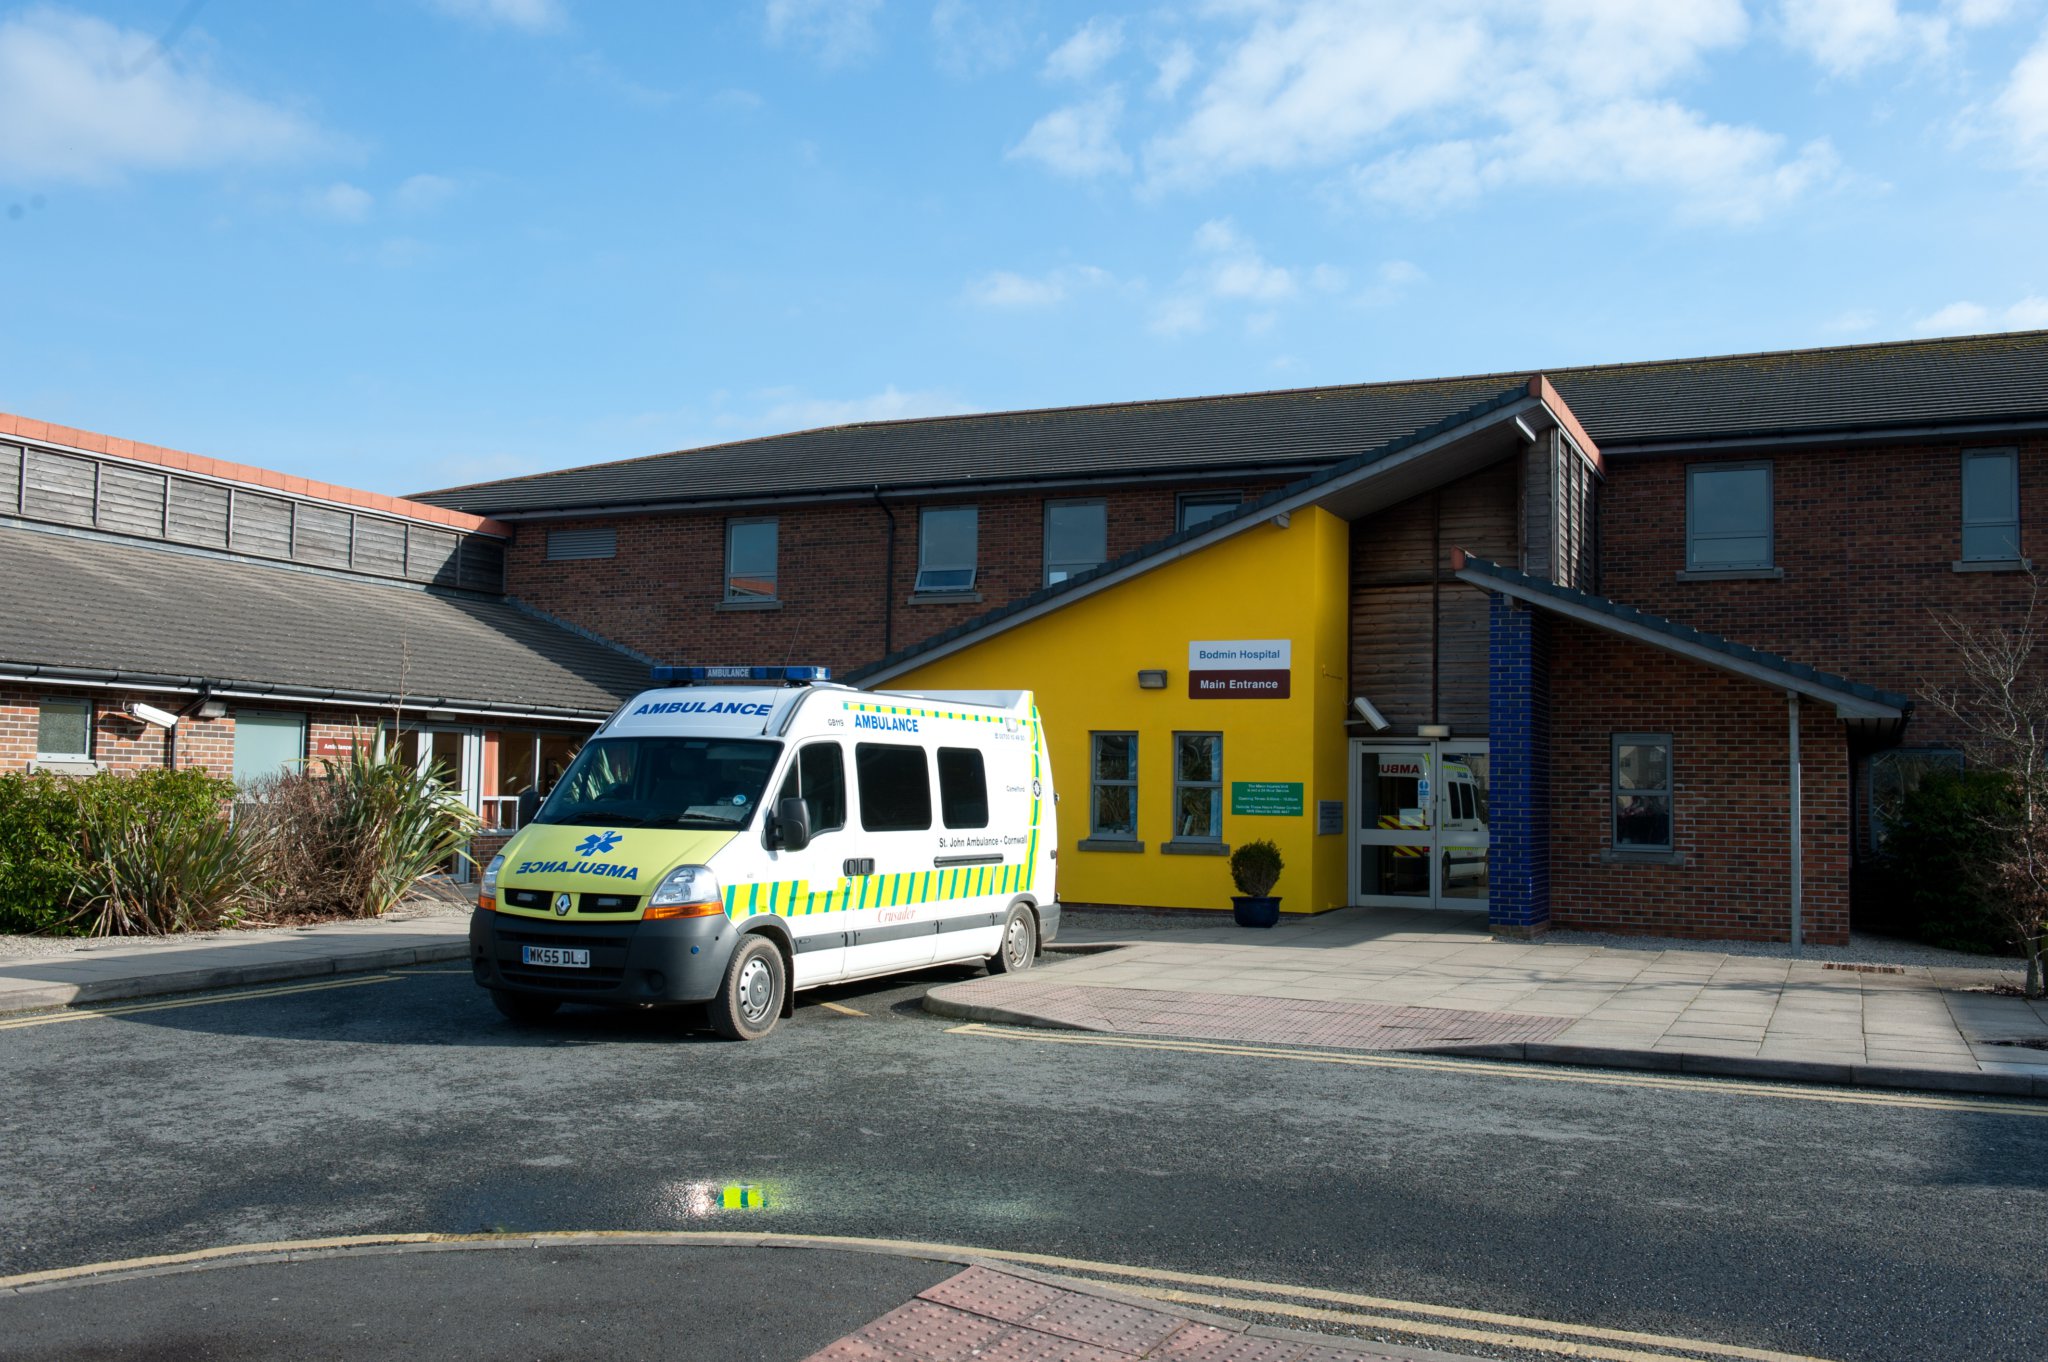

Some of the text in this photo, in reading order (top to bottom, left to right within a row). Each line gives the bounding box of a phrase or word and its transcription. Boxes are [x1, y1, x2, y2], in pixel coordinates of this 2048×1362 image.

[1199, 649, 1280, 661] Bodmin Hospital
[707, 667, 749, 677] AMBULANCE
[1200, 679, 1279, 689] Main Entrance
[633, 701, 774, 716] AMBULANCE
[854, 713, 919, 732] AMBULANCE
[938, 837, 948, 848] St.
[949, 837, 965, 848] John
[966, 836, 999, 847] Ambulance
[1003, 834, 1028, 845] Cornwall
[877, 905, 916, 923] Crusader
[529, 947, 588, 965] WK55 DLJ
